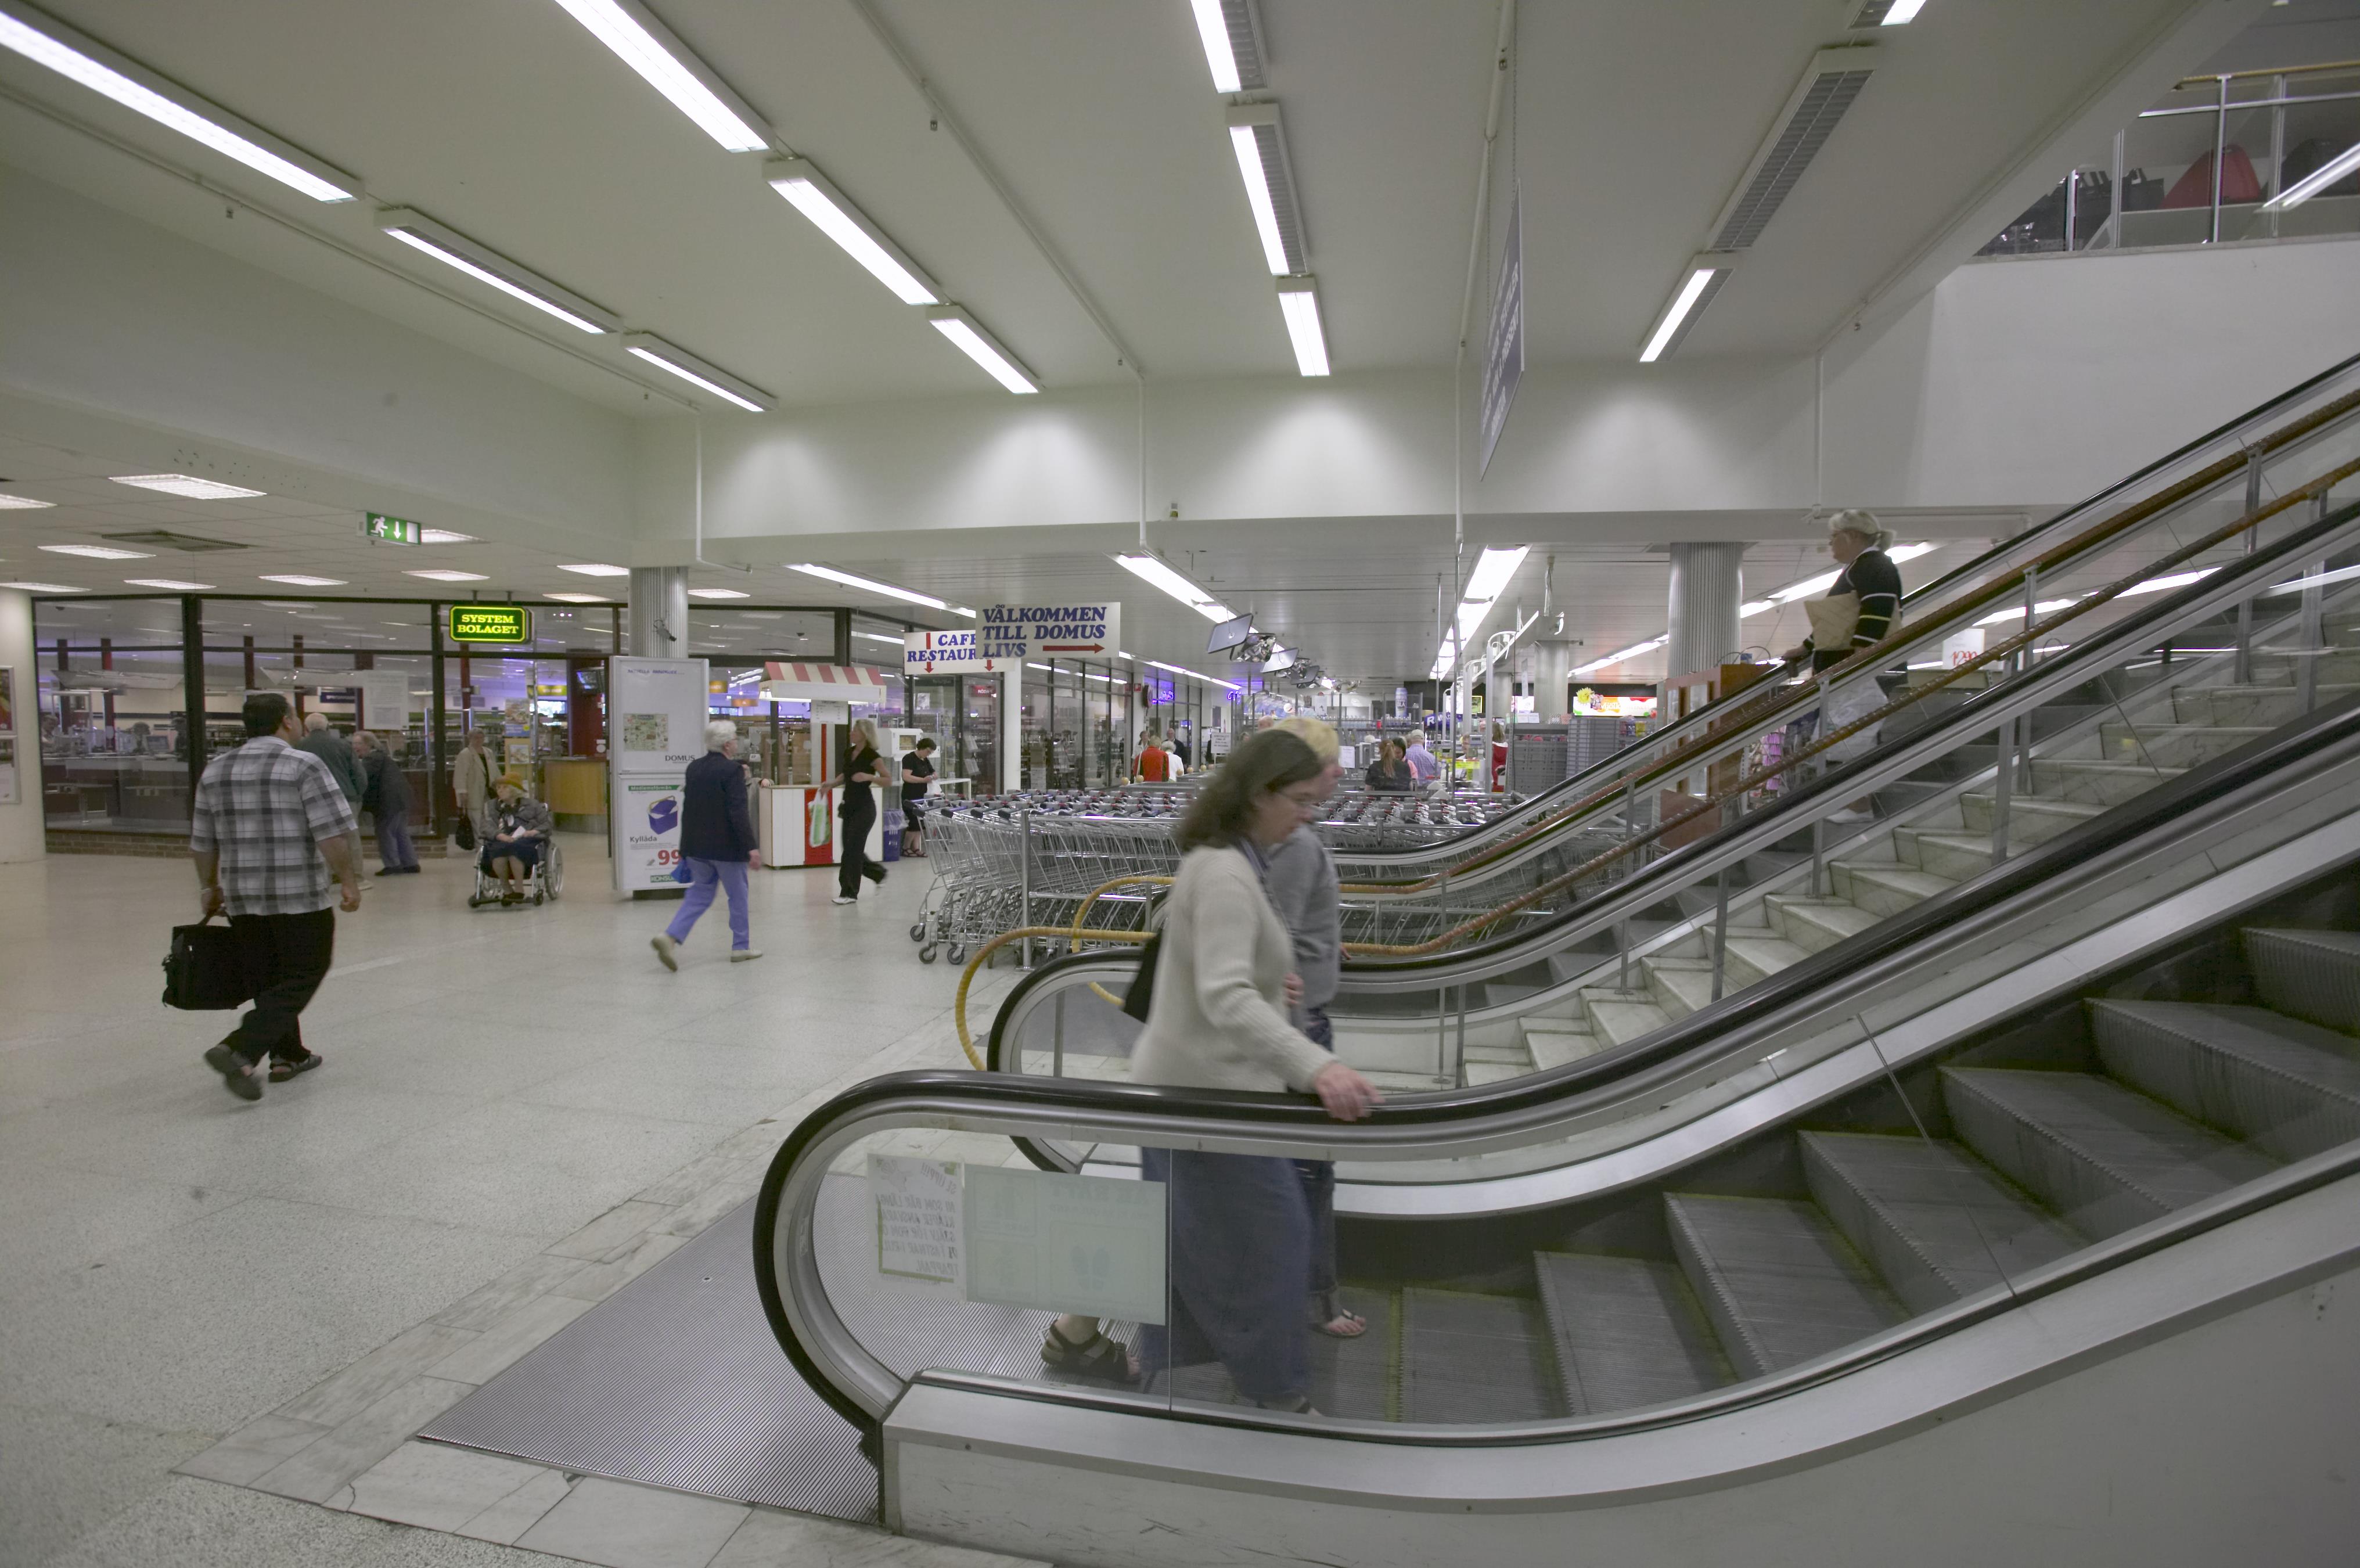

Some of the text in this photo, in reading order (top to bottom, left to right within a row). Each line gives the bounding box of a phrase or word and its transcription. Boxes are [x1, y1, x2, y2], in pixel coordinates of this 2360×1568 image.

[462, 614, 514, 623] SYSTEM
[983, 605, 1107, 623] VÄLKOMMEN
[457, 625, 519, 634] BOLAGET
[983, 624, 1106, 640] TILL DOMUS
[906, 648, 977, 662] RESTAUR
[983, 642, 1027, 657] LIVS
[630, 835, 657, 843] Kyllåda
[658, 849, 682, 865] 99
